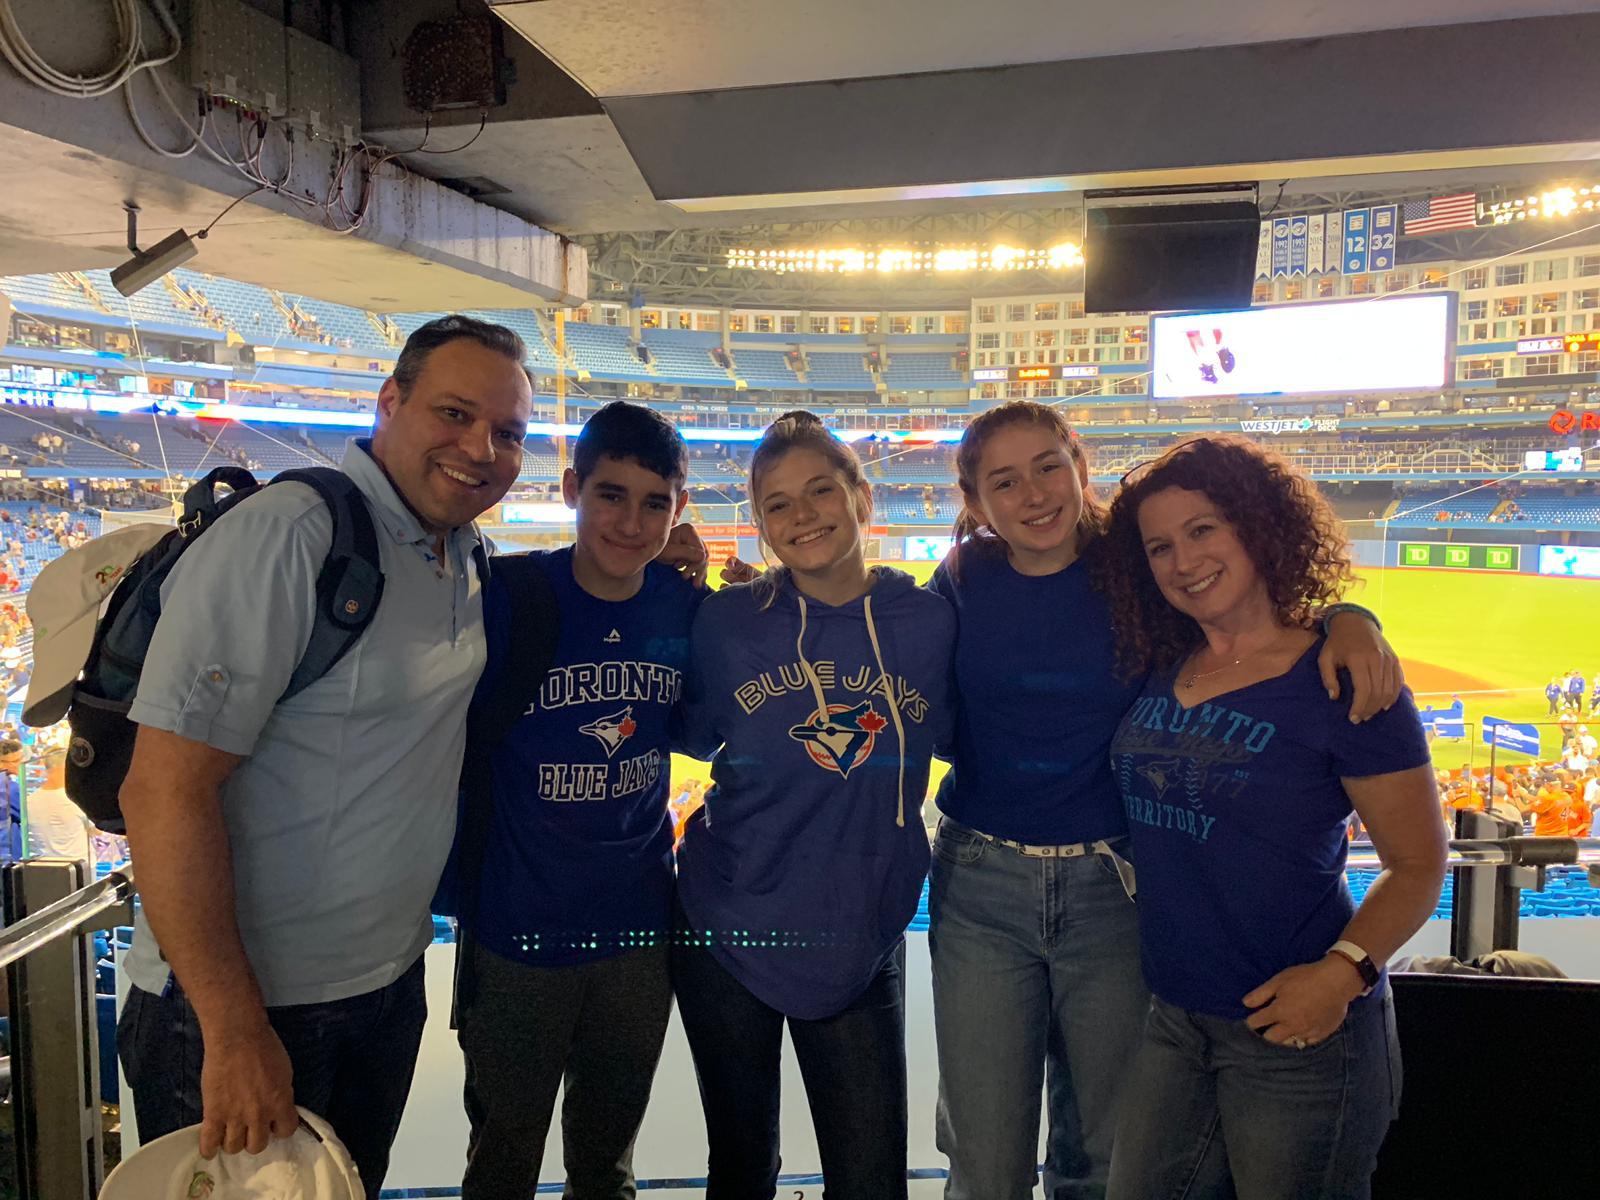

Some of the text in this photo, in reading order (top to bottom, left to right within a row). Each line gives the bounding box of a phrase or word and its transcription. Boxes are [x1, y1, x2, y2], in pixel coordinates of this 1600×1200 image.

[1346, 236, 1365, 253] 12
[1371, 233, 1394, 251] 32
[1242, 420, 1294, 432] WESTJET
[733, 660, 931, 724] BLUE JAYS
[538, 748, 661, 802] BLUE JAYS
